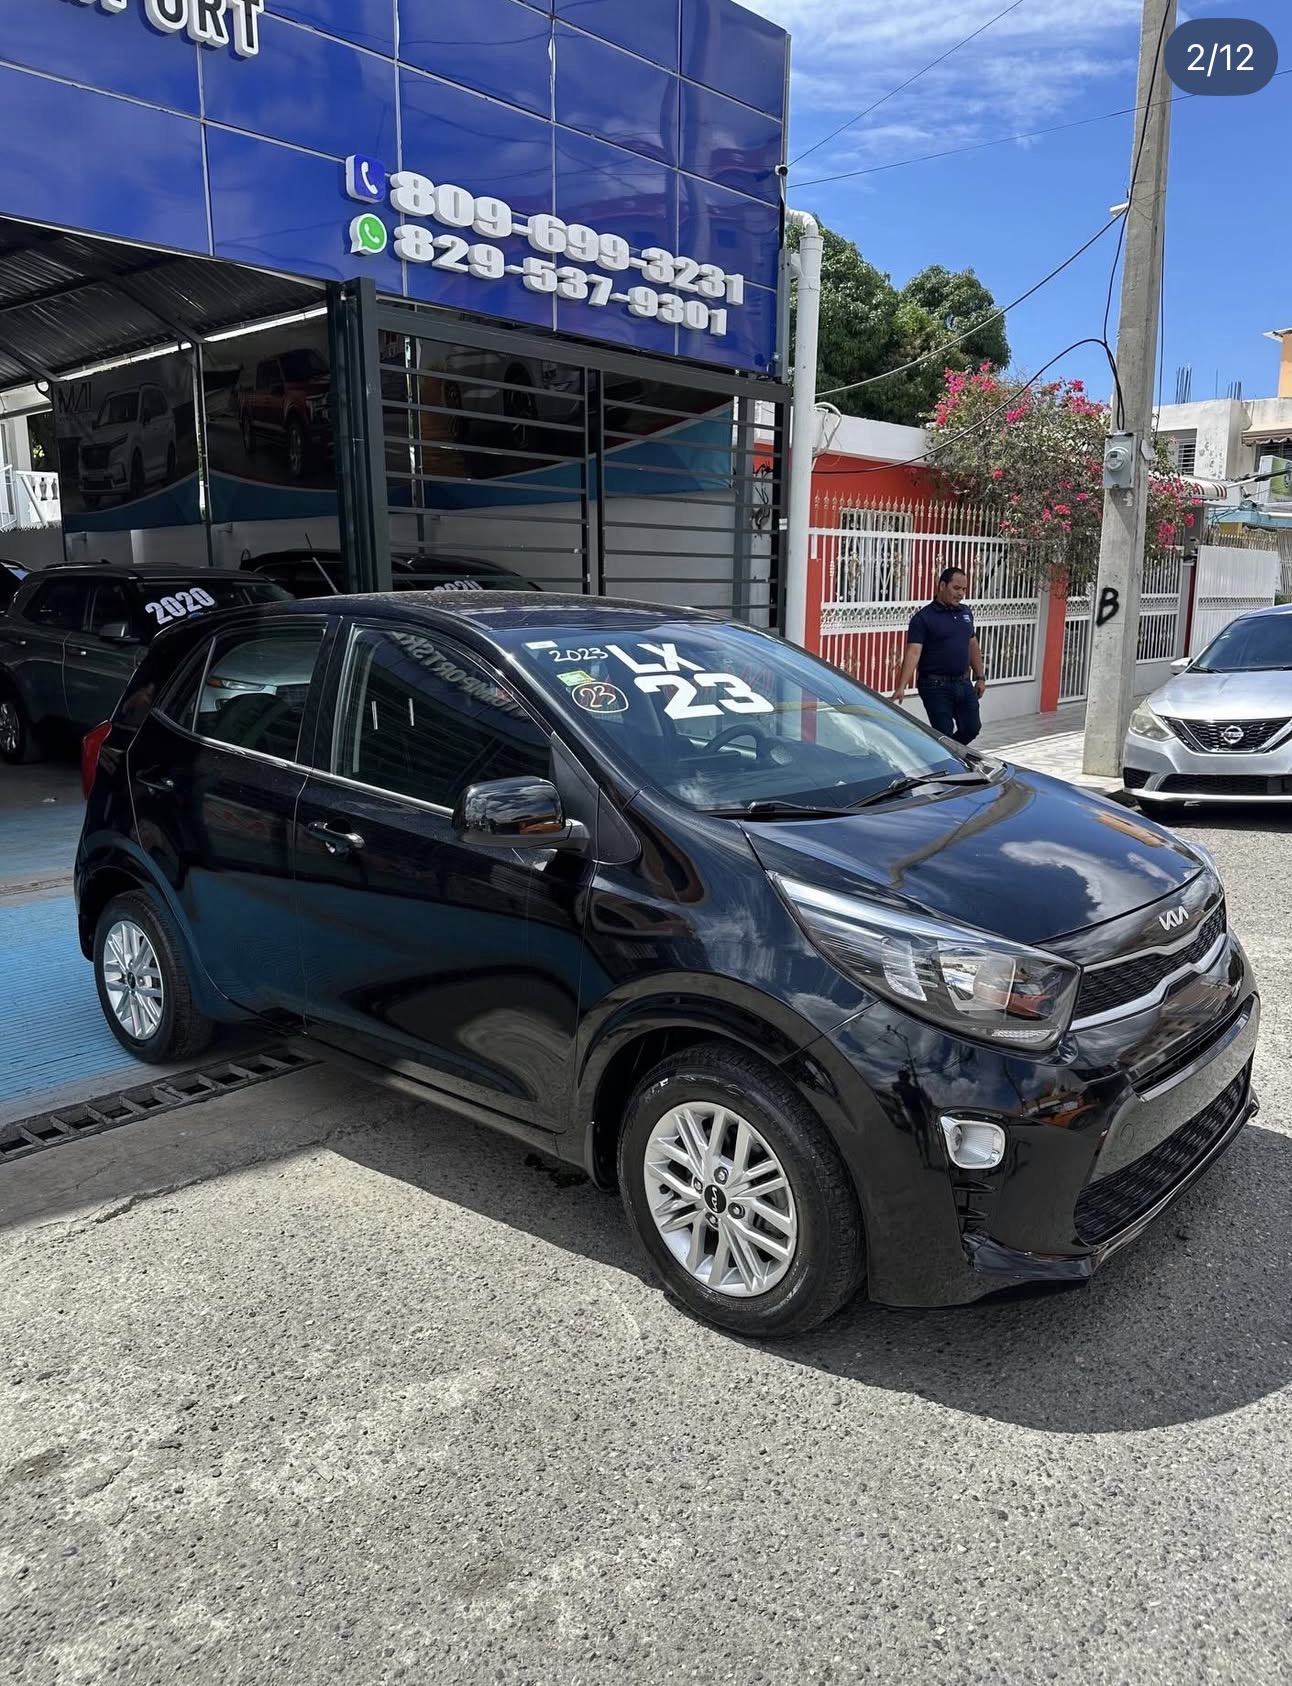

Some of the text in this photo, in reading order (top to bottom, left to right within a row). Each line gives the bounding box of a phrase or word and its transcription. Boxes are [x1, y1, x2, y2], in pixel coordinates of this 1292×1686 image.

[389, 170, 744, 305] 809-699-3231
[394, 224, 728, 336] 829-537-9301
[144, 587, 216, 625] 2020
[1096, 587, 1120, 628] B
[549, 648, 609, 662] 2023
[605, 643, 706, 674] LX
[580, 685, 617, 708] 23
[634, 673, 775, 720] 23
[1158, 905, 1189, 931] KIA
